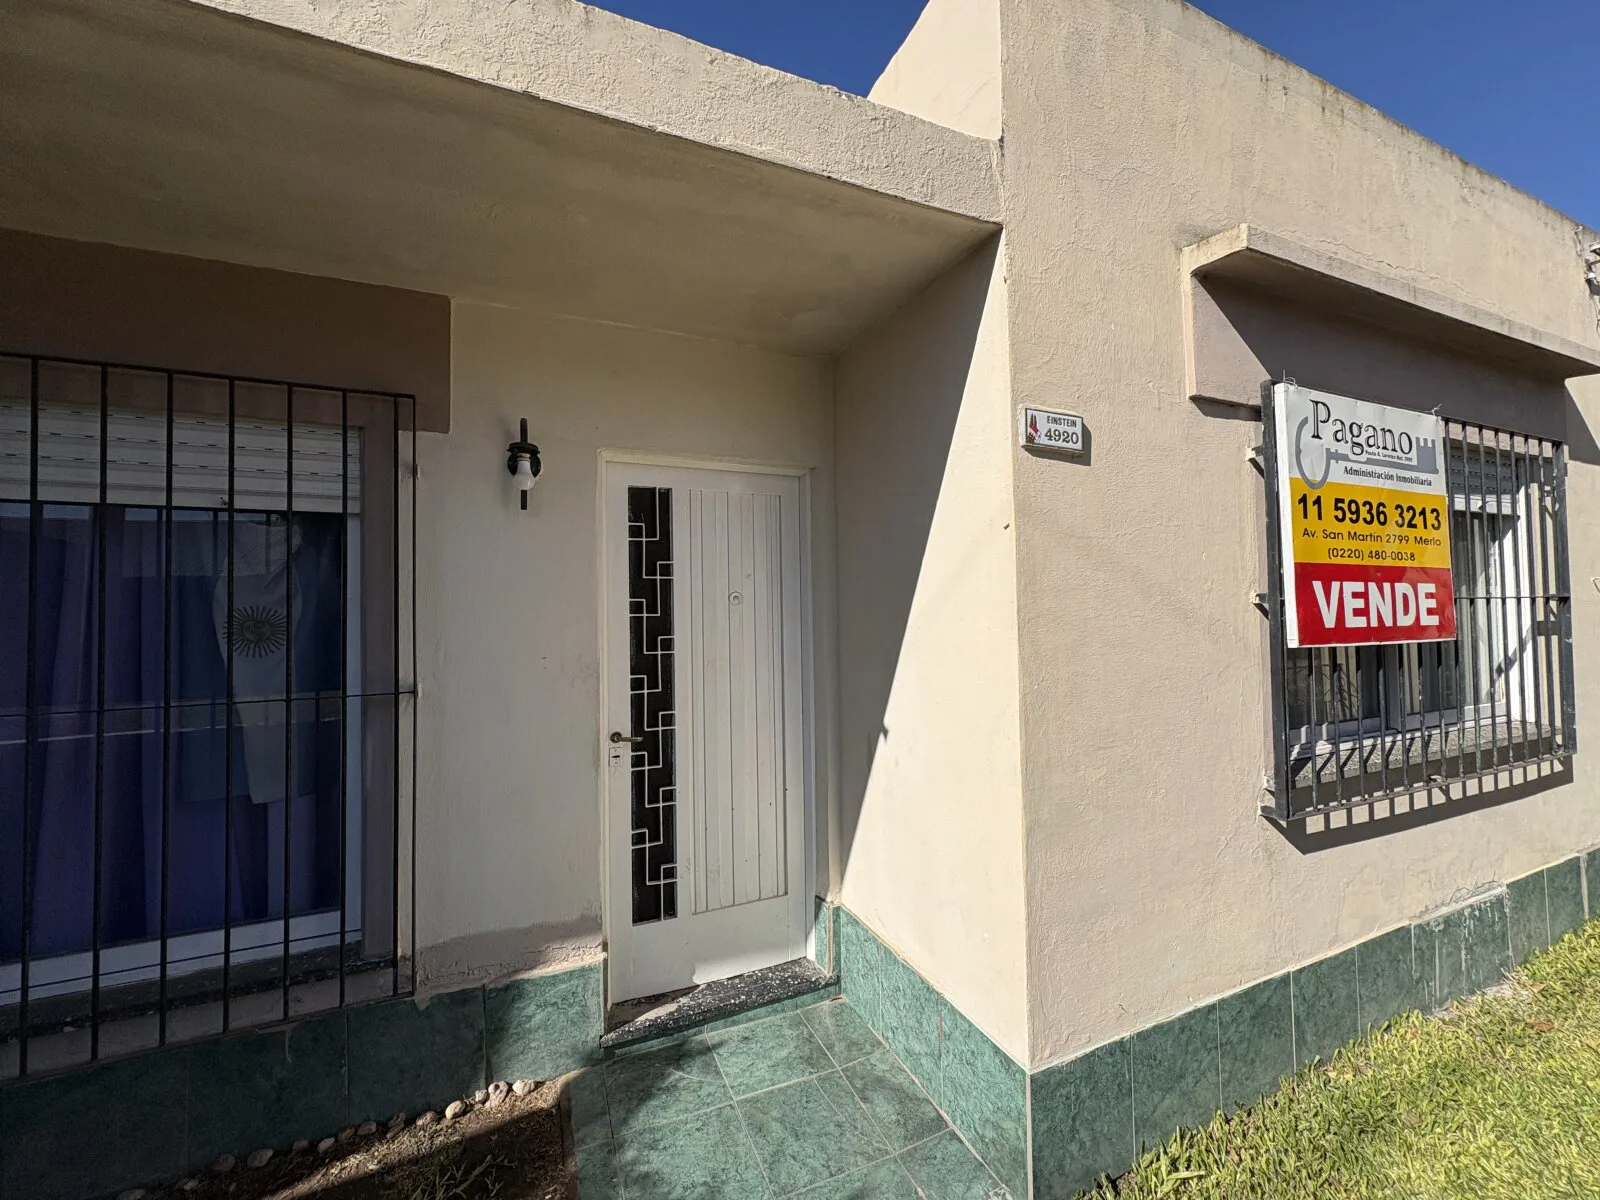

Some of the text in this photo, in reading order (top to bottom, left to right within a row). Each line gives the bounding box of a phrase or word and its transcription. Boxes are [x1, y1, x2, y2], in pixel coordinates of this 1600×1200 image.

[1046, 415, 1077, 428] EINSTEIN
[1309, 399, 1412, 456] Pagano
[1044, 428, 1079, 445] 4920
[1343, 466, 1432, 487] Administración Inmobiliaria
[1298, 493, 1441, 531] 11 5936 3213
[1302, 528, 1442, 547] Av. San Martín 2799 Merlo
[1328, 547, 1416, 562] (0220) 480-0038
[1312, 580, 1440, 629] VENDE
